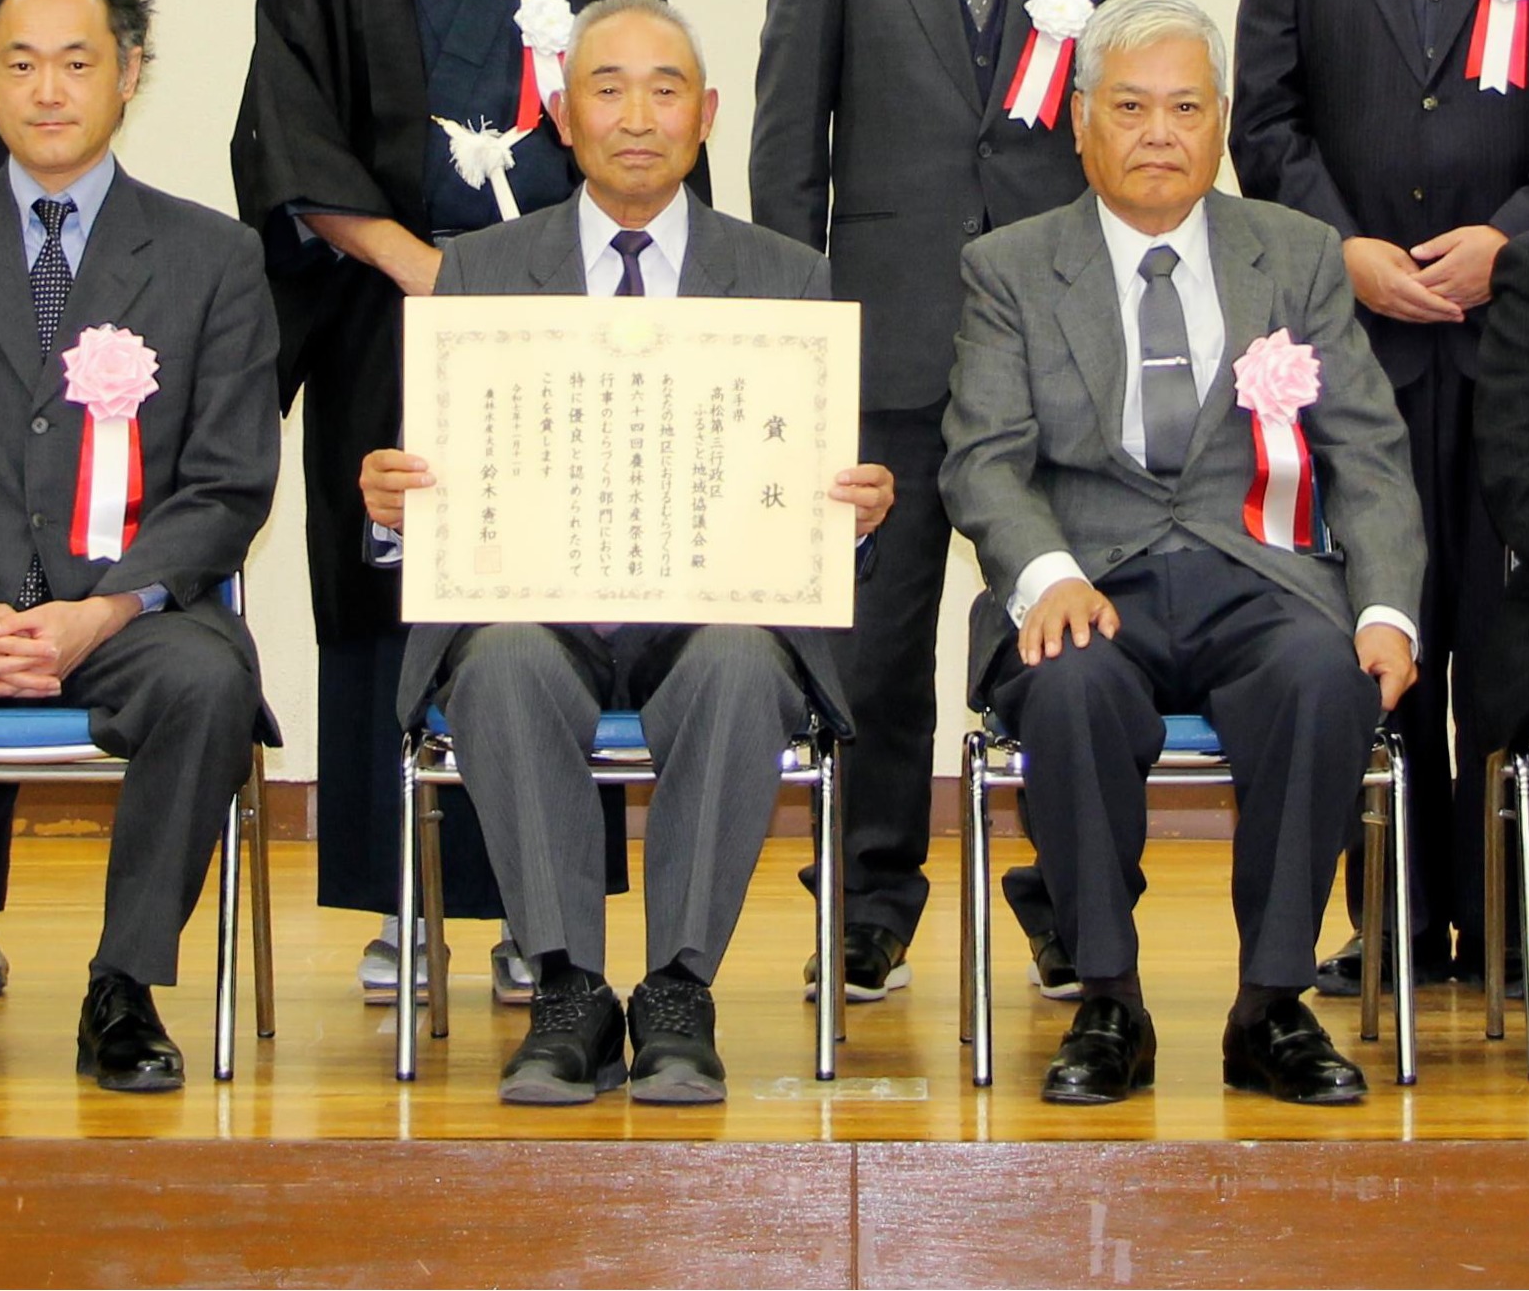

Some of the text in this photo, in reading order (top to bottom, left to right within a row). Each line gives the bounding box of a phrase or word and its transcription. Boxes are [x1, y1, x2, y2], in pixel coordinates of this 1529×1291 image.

[539, 372, 555, 479] これを賞します
[709, 385, 726, 499] 高松第三行政区
[732, 376, 746, 423] 岩手県
[759, 414, 788, 510] 賞状
[567, 371, 586, 577] 特に優良と認められたので
[598, 372, 615, 577] 行事のむらづくり部門において
[627, 371, 646, 577] 第六十四回農林水産祭表彰
[659, 373, 676, 578] あなたの地区におけるむらづくりは
[690, 403, 707, 548] ふるさと地域協議会
